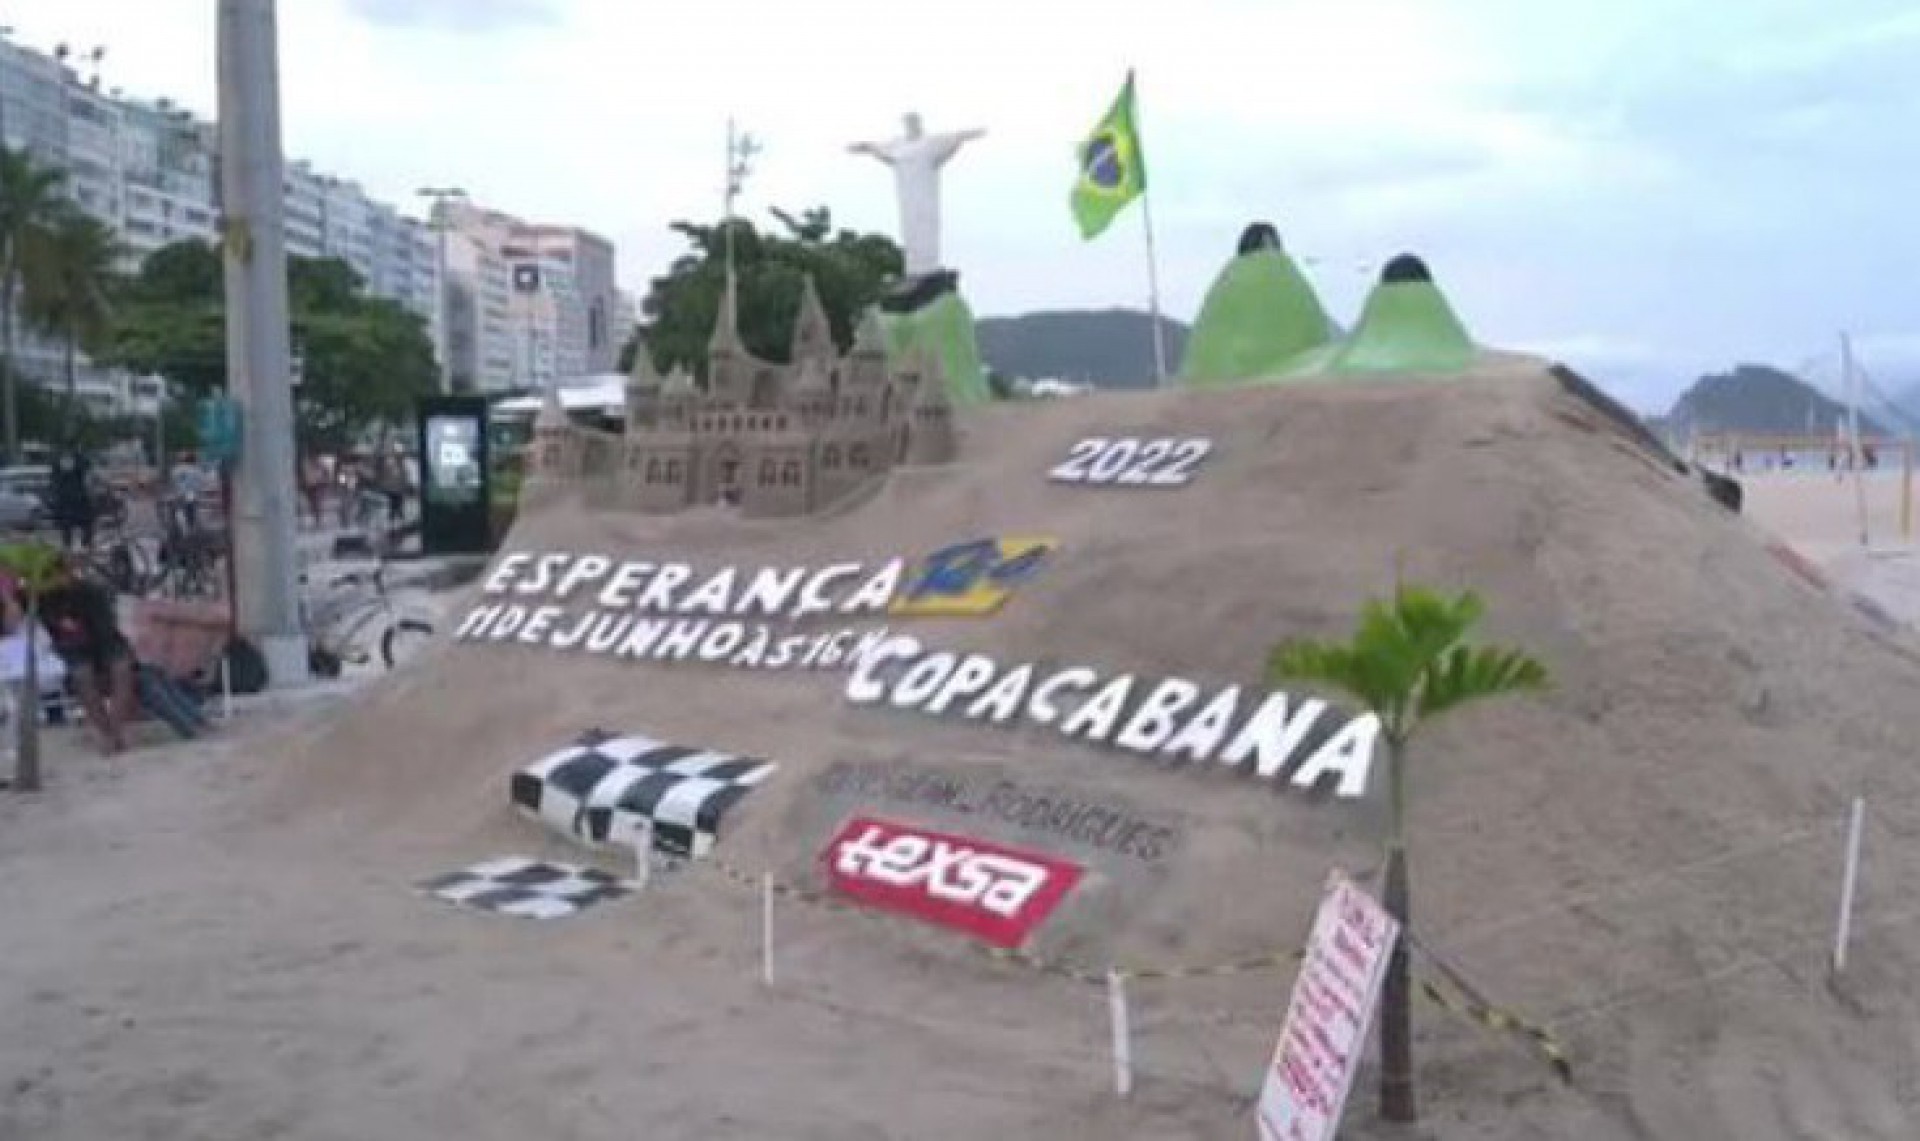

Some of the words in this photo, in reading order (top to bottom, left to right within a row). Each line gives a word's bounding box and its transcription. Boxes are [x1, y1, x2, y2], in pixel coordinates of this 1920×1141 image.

[1049, 437, 1212, 484] 2022
[484, 552, 904, 616] ESPERANÇA
[489, 605, 564, 642] DE
[550, 611, 745, 659] JUNHO
[846, 635, 1381, 797] COPACABANA
[837, 826, 1050, 918] texsa
